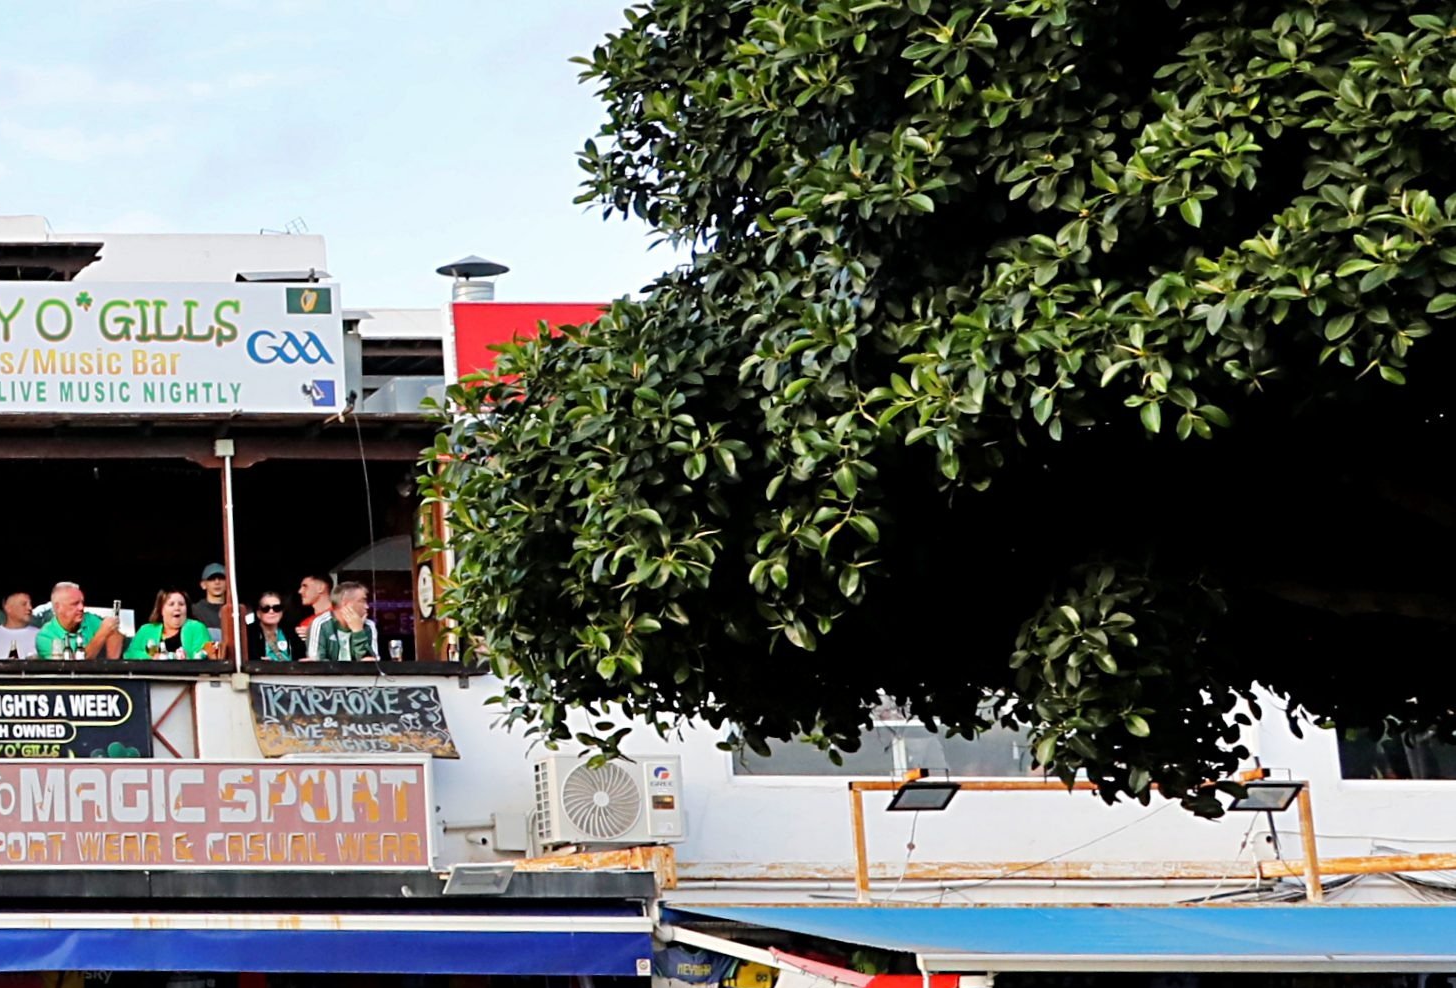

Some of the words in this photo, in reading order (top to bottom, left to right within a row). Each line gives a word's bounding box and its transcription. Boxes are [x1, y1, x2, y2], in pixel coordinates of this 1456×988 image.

[133, 348, 181, 377] Bar
[247, 329, 334, 367] GAA
[56, 381, 132, 403] MUSIC
[143, 381, 243, 404] NIGHTLY
[52, 693, 67, 717] A
[70, 693, 120, 718] WEEK
[265, 687, 402, 716] KARAOKE
[10, 723, 66, 740] OWNED
[280, 723, 324, 739] LIVE
[342, 722, 401, 737] MUSIC
[21, 768, 205, 824] MAGIC
[217, 766, 417, 824] SPORT
[78, 831, 161, 862] WEAR
[172, 833, 194, 863] &
[205, 832, 326, 862] CASUAL
[336, 831, 422, 861] WEAR
